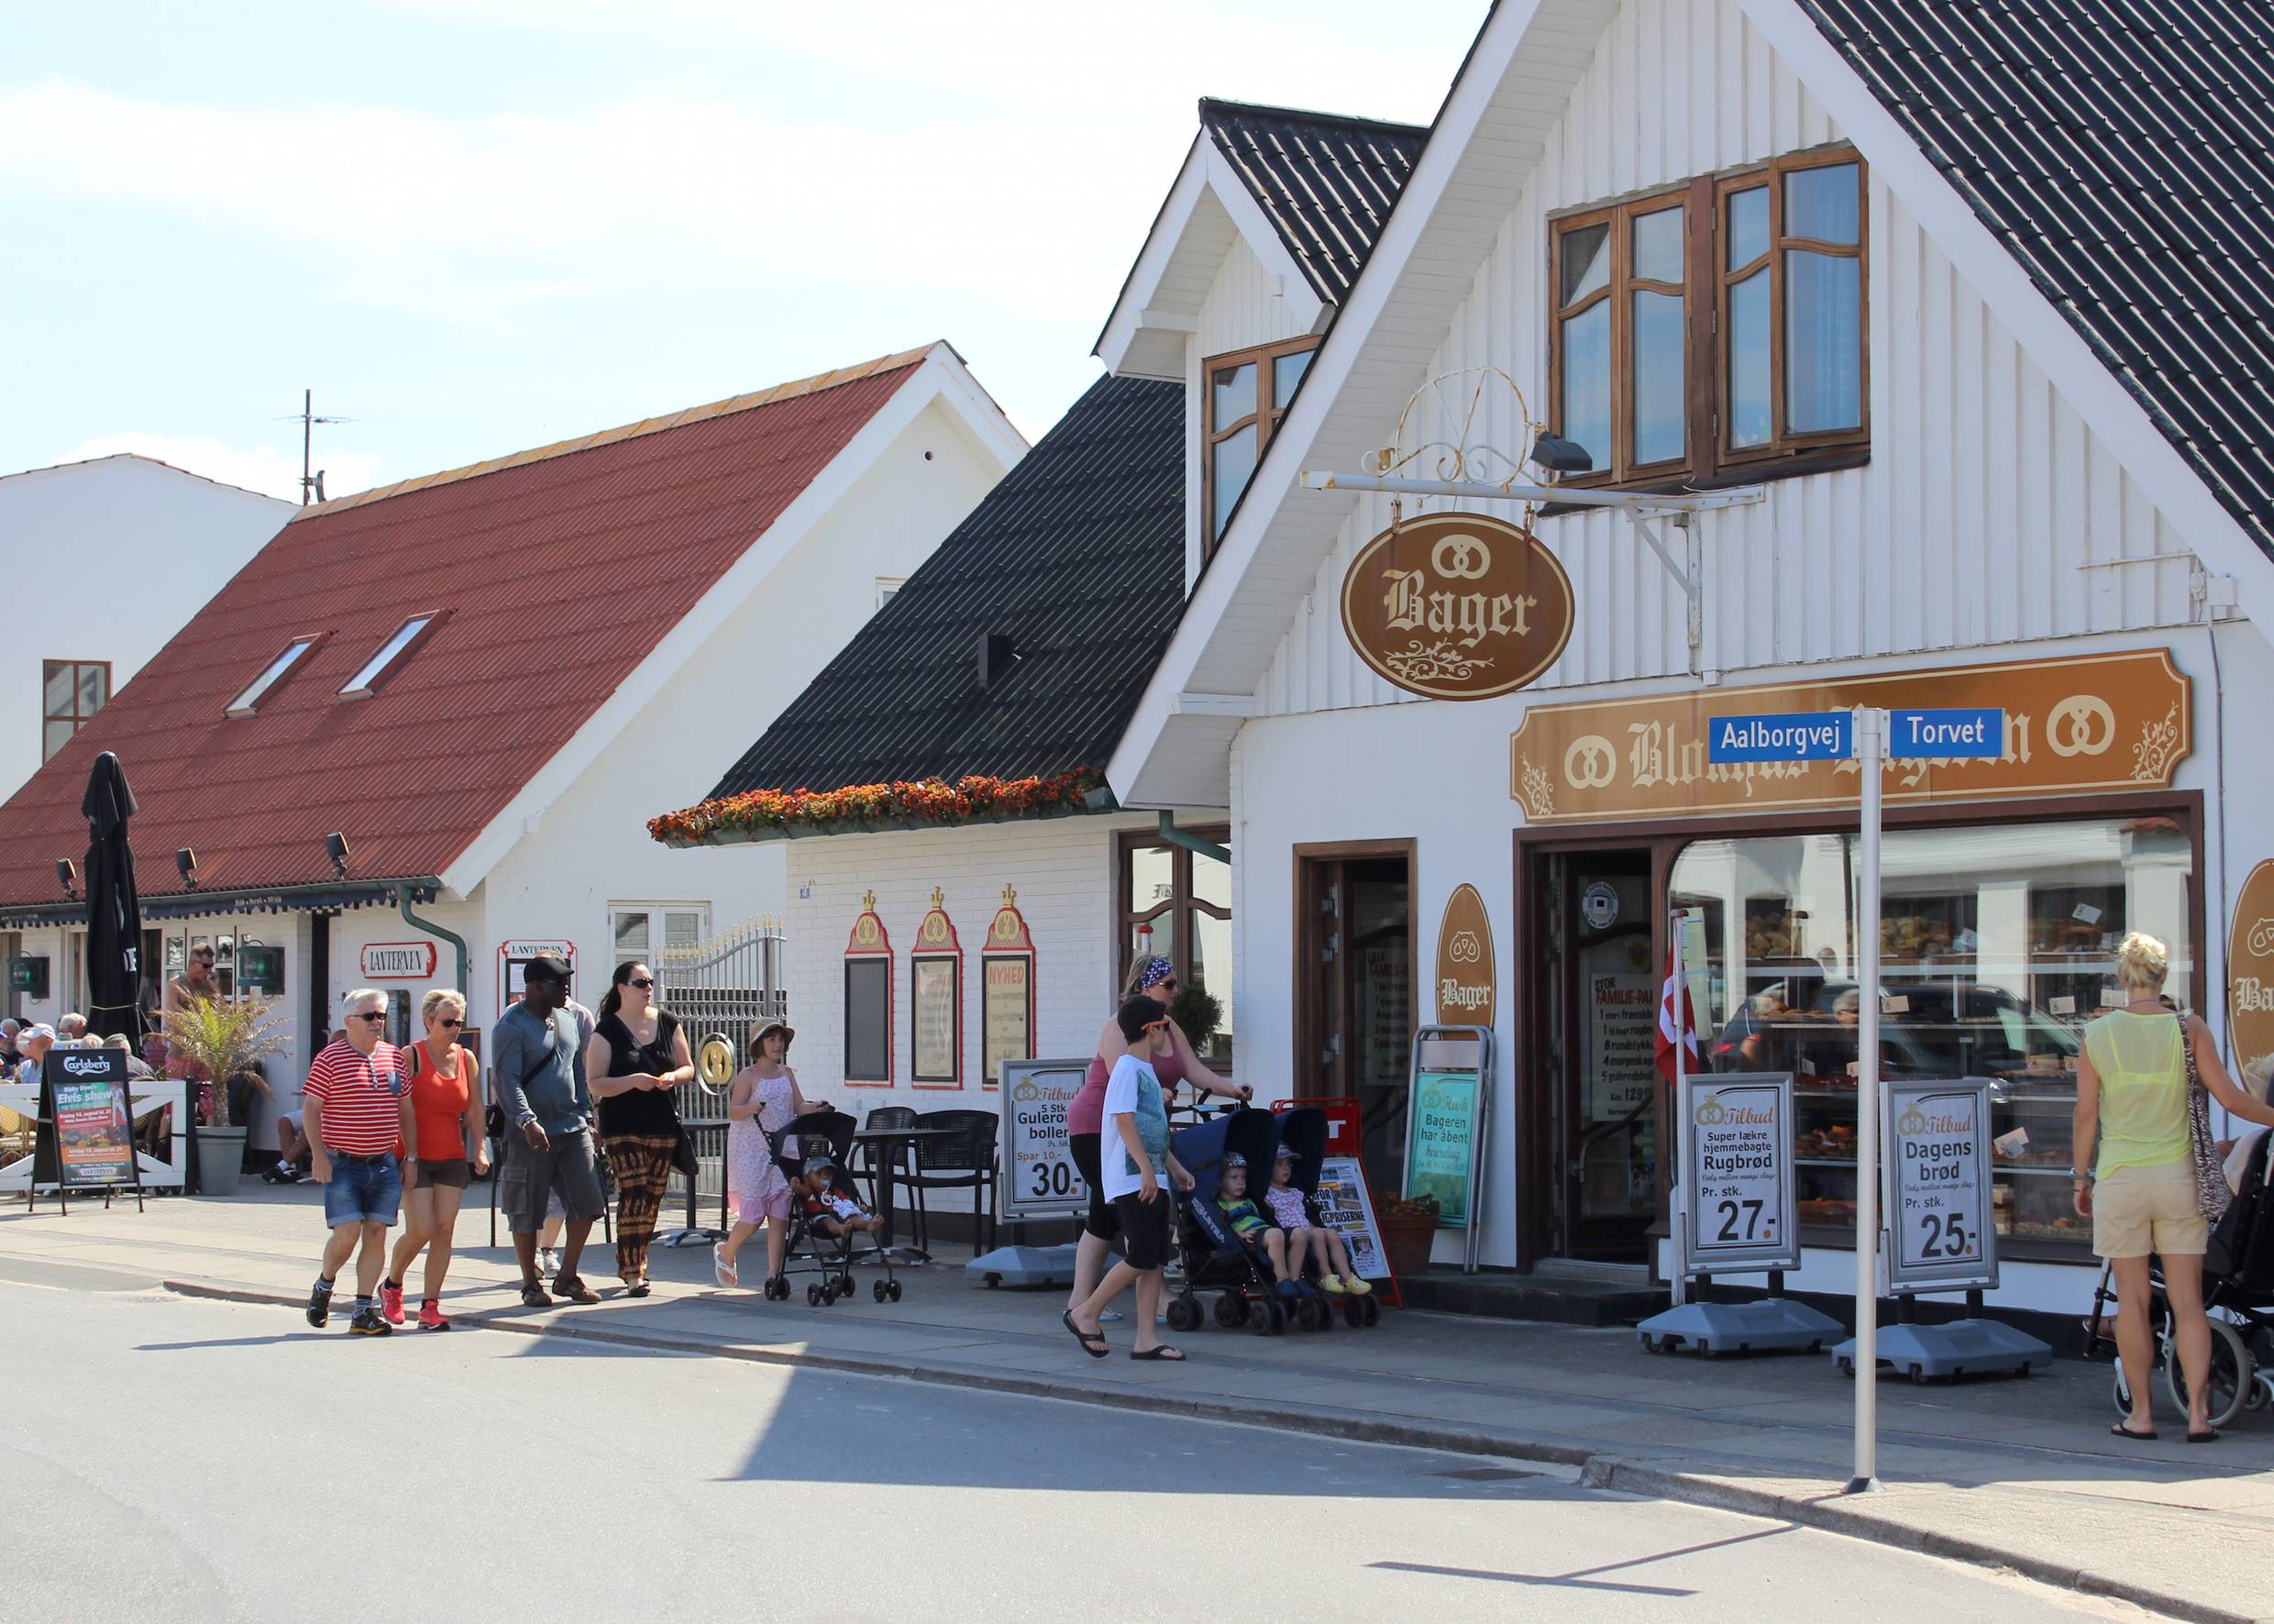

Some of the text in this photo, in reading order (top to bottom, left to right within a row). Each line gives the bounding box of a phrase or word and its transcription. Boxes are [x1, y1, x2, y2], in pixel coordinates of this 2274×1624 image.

[1382, 569, 1538, 648] Bager
[1720, 720, 1839, 755] Aalborgvej
[1907, 716, 1984, 744] Torvet
[370, 950, 423, 975] LANTERNEN
[989, 966, 1024, 985] NYHED
[1441, 978, 1491, 1011] Bager
[2235, 977, 2274, 1016] Ba
[63, 1055, 110, 1073] Carlsberg
[58, 1092, 82, 1104] Elvis
[1018, 1112, 1067, 1124] Gulero
[1042, 1105, 1047, 1113] 5
[1724, 1107, 1774, 1125] Tilbud
[1425, 1113, 1466, 1130] Bageren
[1926, 1115, 1972, 1134] Tilbud
[1030, 1127, 1068, 1139] boller
[1421, 1128, 1468, 1144] har åbent
[1707, 1131, 1768, 1144] Super lækre
[1017, 1152, 1039, 1163] Spar
[1704, 1143, 1772, 1154] hjemmebagte
[1905, 1142, 1971, 1162] Dagens
[1705, 1154, 1772, 1173] Rugbrød
[1920, 1161, 1959, 1181] brød
[1702, 1186, 1742, 1198] Pr. stk.
[1905, 1196, 1944, 1209] Pr. stk.
[1321, 1210, 1366, 1224] IGPRISERNE
